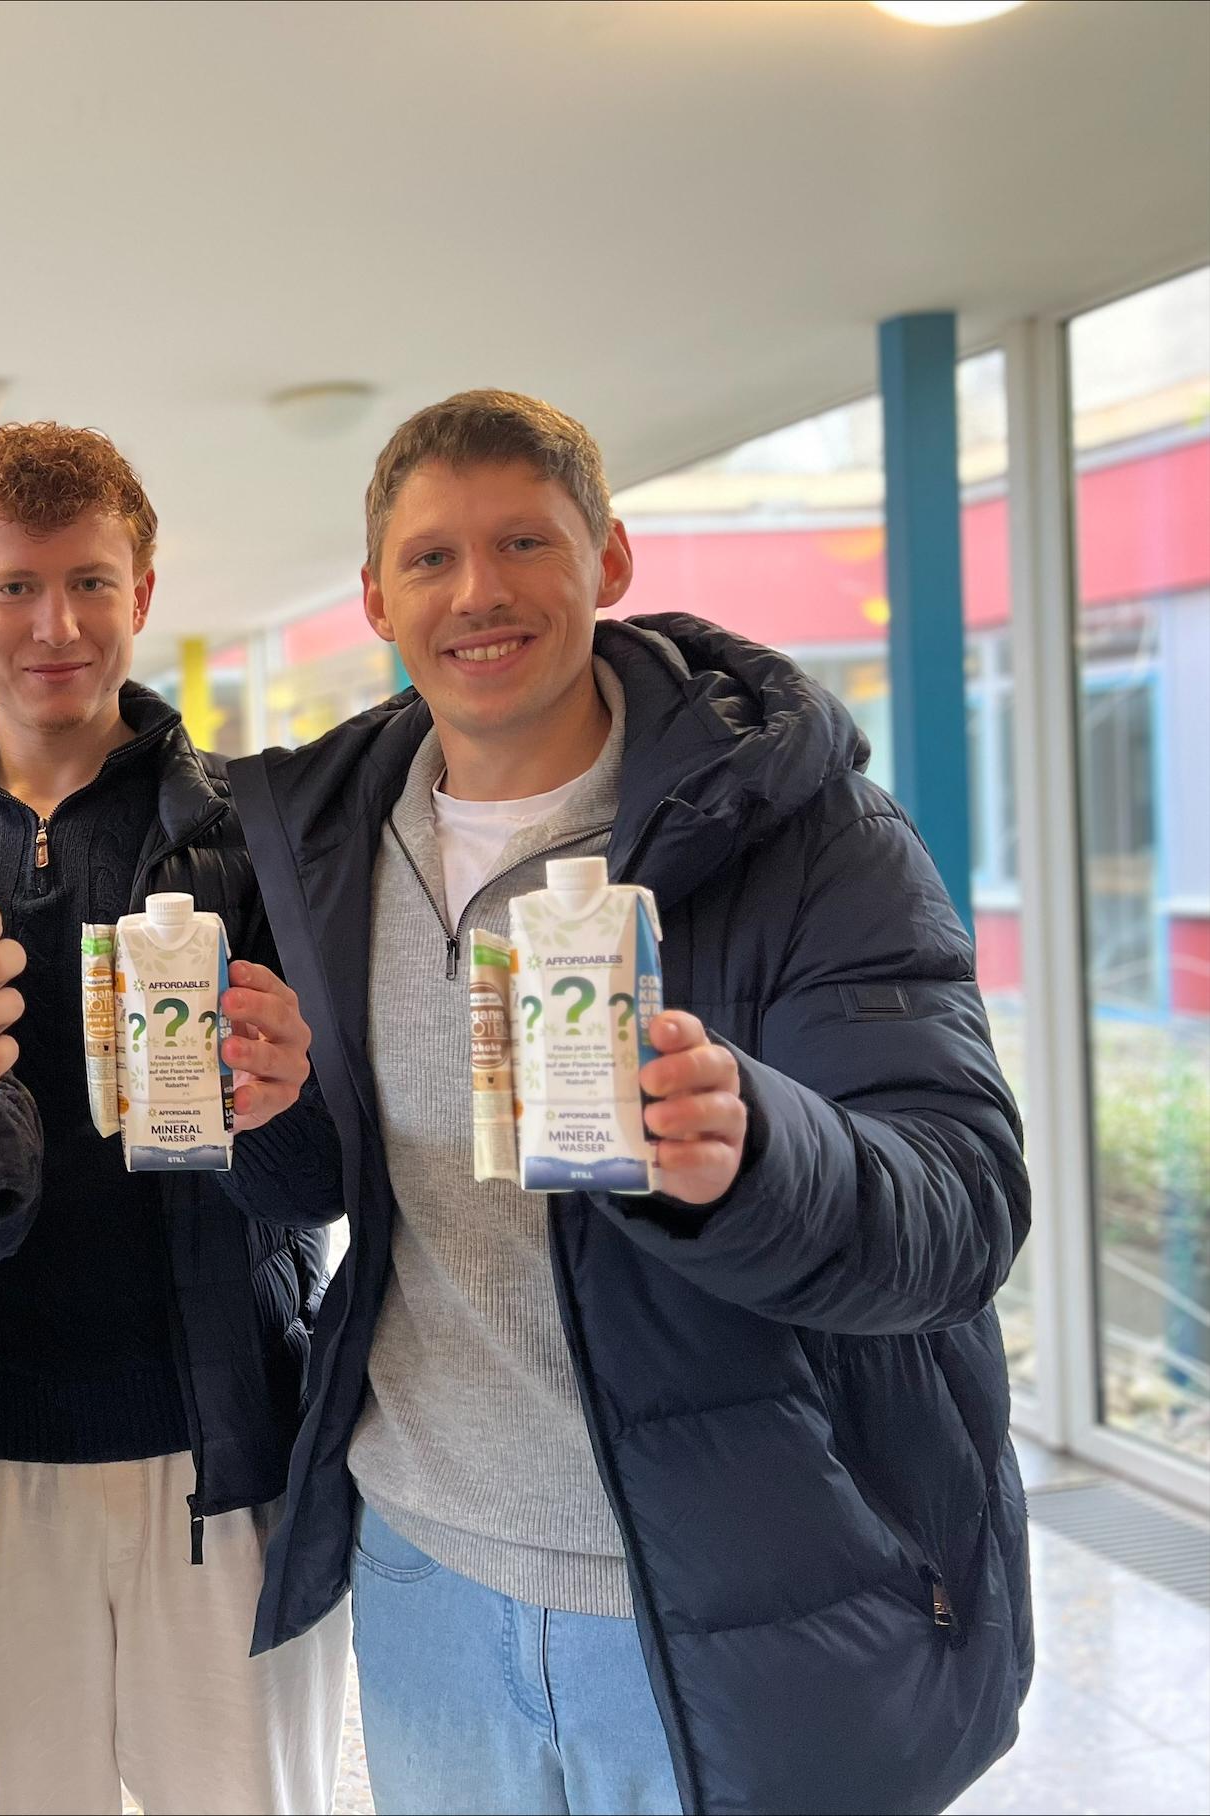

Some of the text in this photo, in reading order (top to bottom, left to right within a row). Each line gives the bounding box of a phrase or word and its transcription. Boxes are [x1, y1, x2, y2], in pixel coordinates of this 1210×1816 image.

[545, 955, 623, 966] AFFORDABLES
[149, 981, 210, 989] AFFORDABLES
[551, 976, 596, 1036] ?
[153, 998, 189, 1047] ?
[151, 1125, 203, 1135] MINERAL
[549, 1131, 614, 1142] MINERAL
[558, 1143, 605, 1152] WASSER
[570, 1171, 593, 1179] STILL
